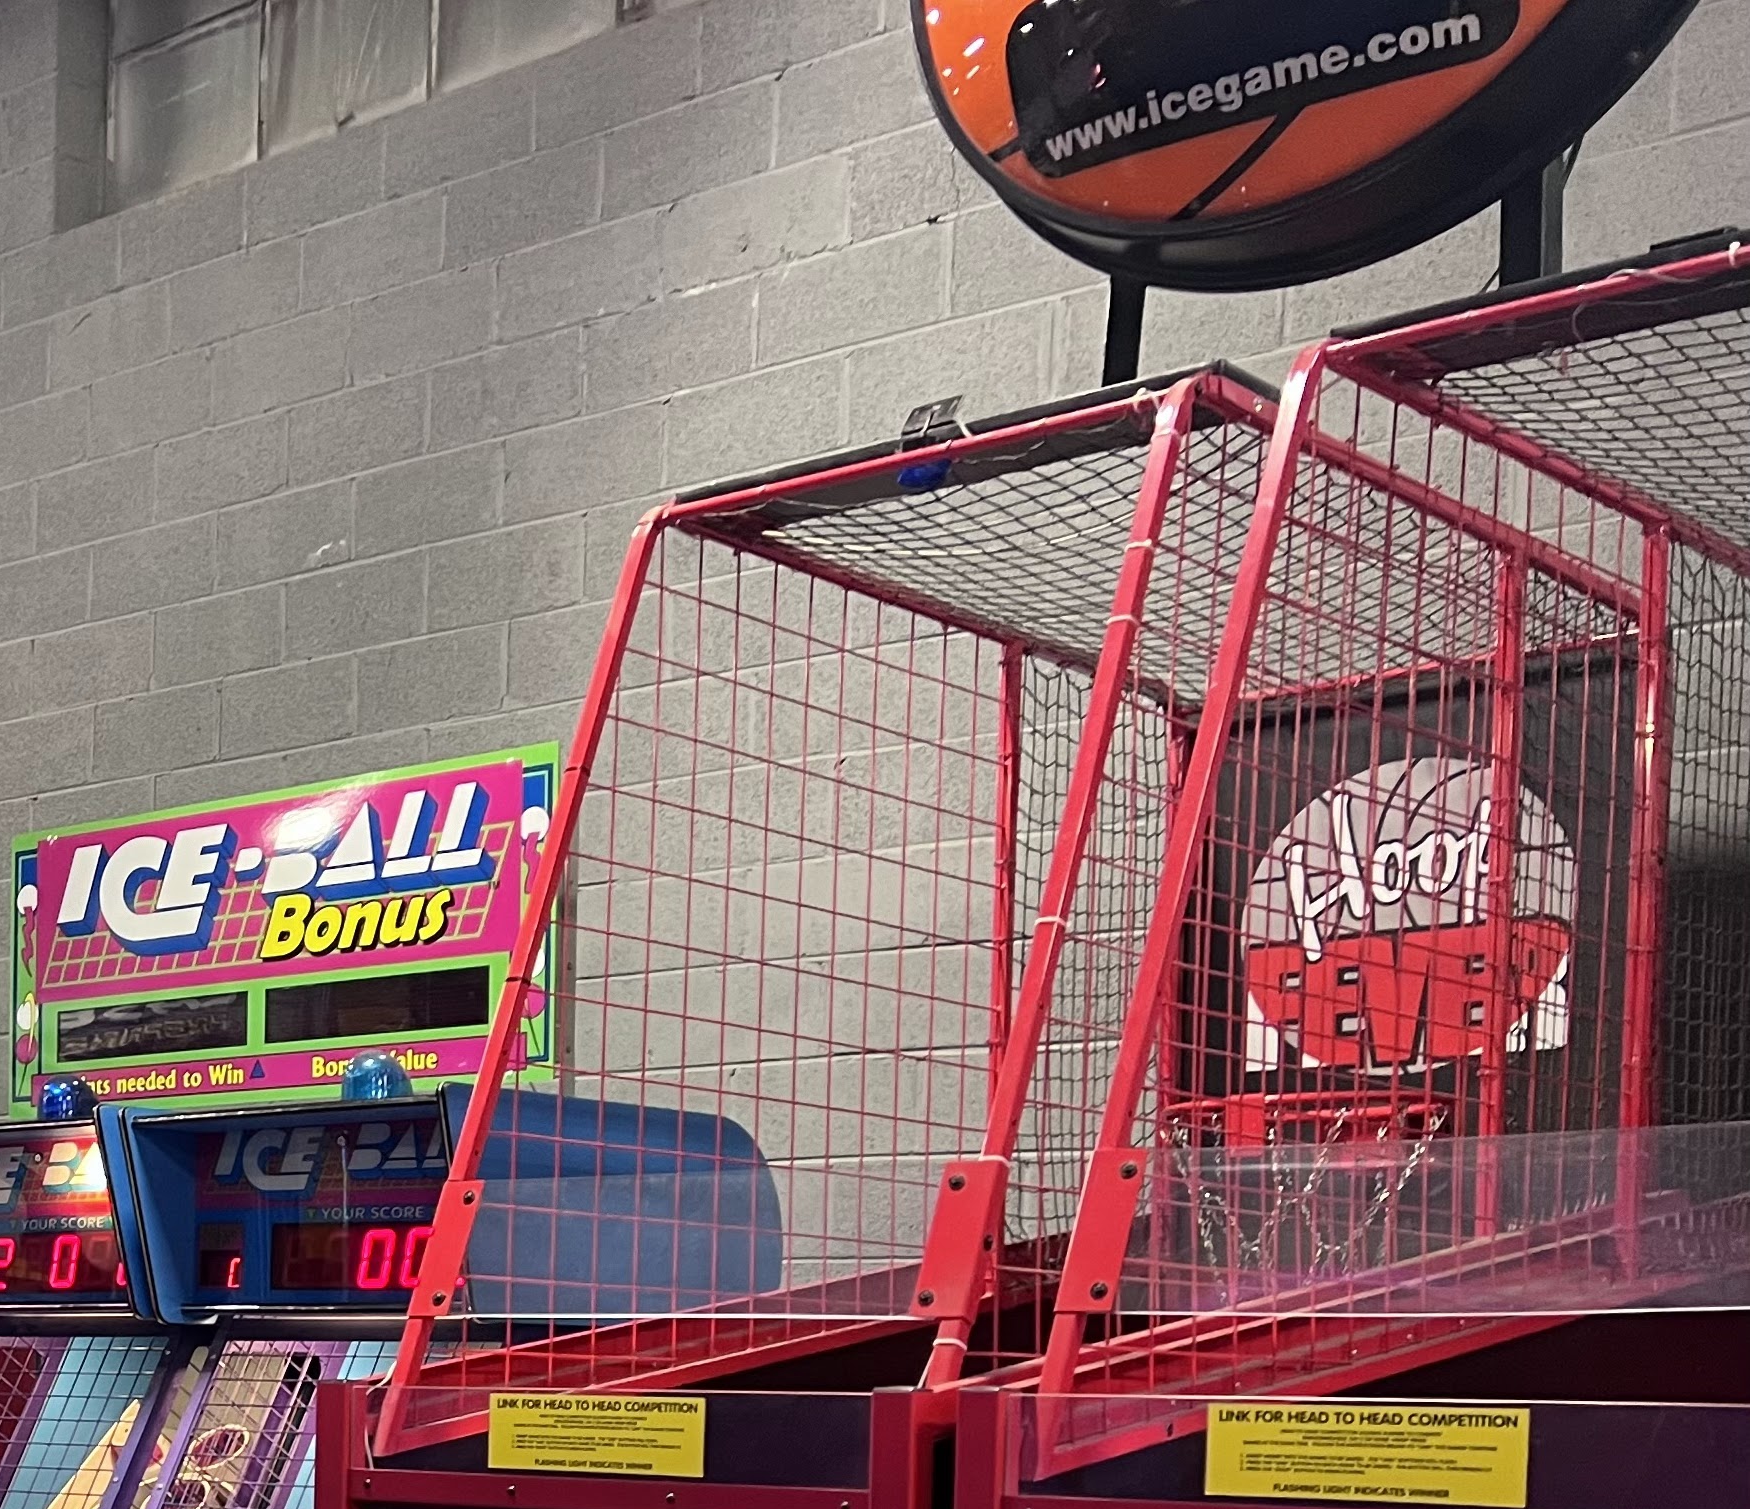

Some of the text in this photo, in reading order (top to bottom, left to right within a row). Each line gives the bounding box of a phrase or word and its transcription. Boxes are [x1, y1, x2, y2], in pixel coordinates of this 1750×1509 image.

[1045, 7, 1482, 164] www.icegame.com
[260, 889, 453, 961] Bonus
[1245, 914, 1573, 1076] FEVER
[116, 1069, 177, 1094] needed
[183, 1070, 203, 1088] to
[209, 1063, 244, 1086] Win
[311, 1049, 438, 1078] Bon alue
[42, 1141, 108, 1187] BA
[214, 1121, 448, 1191] ICE BAL
[21, 1216, 104, 1231] YOUR SCORE
[320, 1205, 425, 1221] YOUR SCORE
[497, 1398, 698, 1414] LINK FOR HEAD TO HEAD COMPETITION
[1219, 1409, 1519, 1428] LINK FOR HEAD TO HEAD COMPETITION
